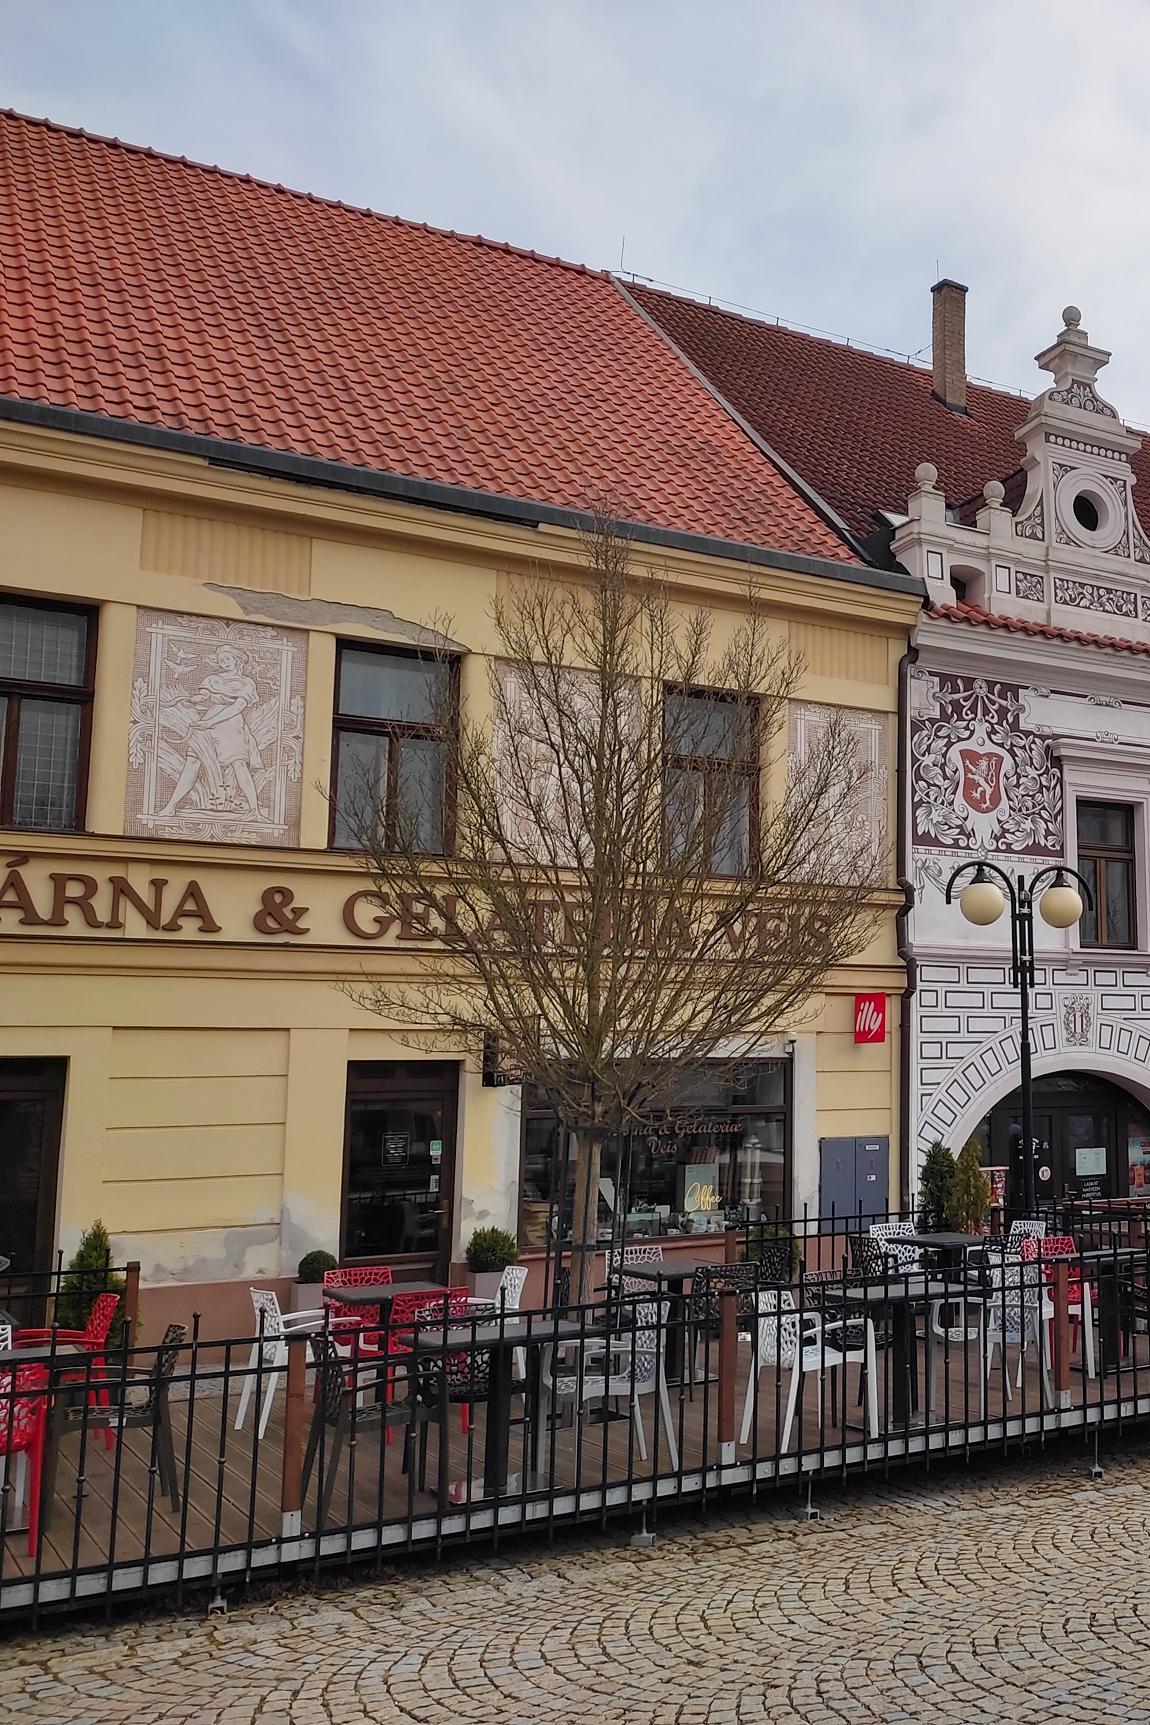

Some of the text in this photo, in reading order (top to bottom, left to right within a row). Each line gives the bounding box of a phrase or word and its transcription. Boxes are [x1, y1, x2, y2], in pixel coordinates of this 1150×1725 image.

[253, 886, 310, 934] &
[856, 1001, 883, 1039] illy
[675, 1119, 744, 1138] Gelateria
[648, 1136, 679, 1154] Veis
